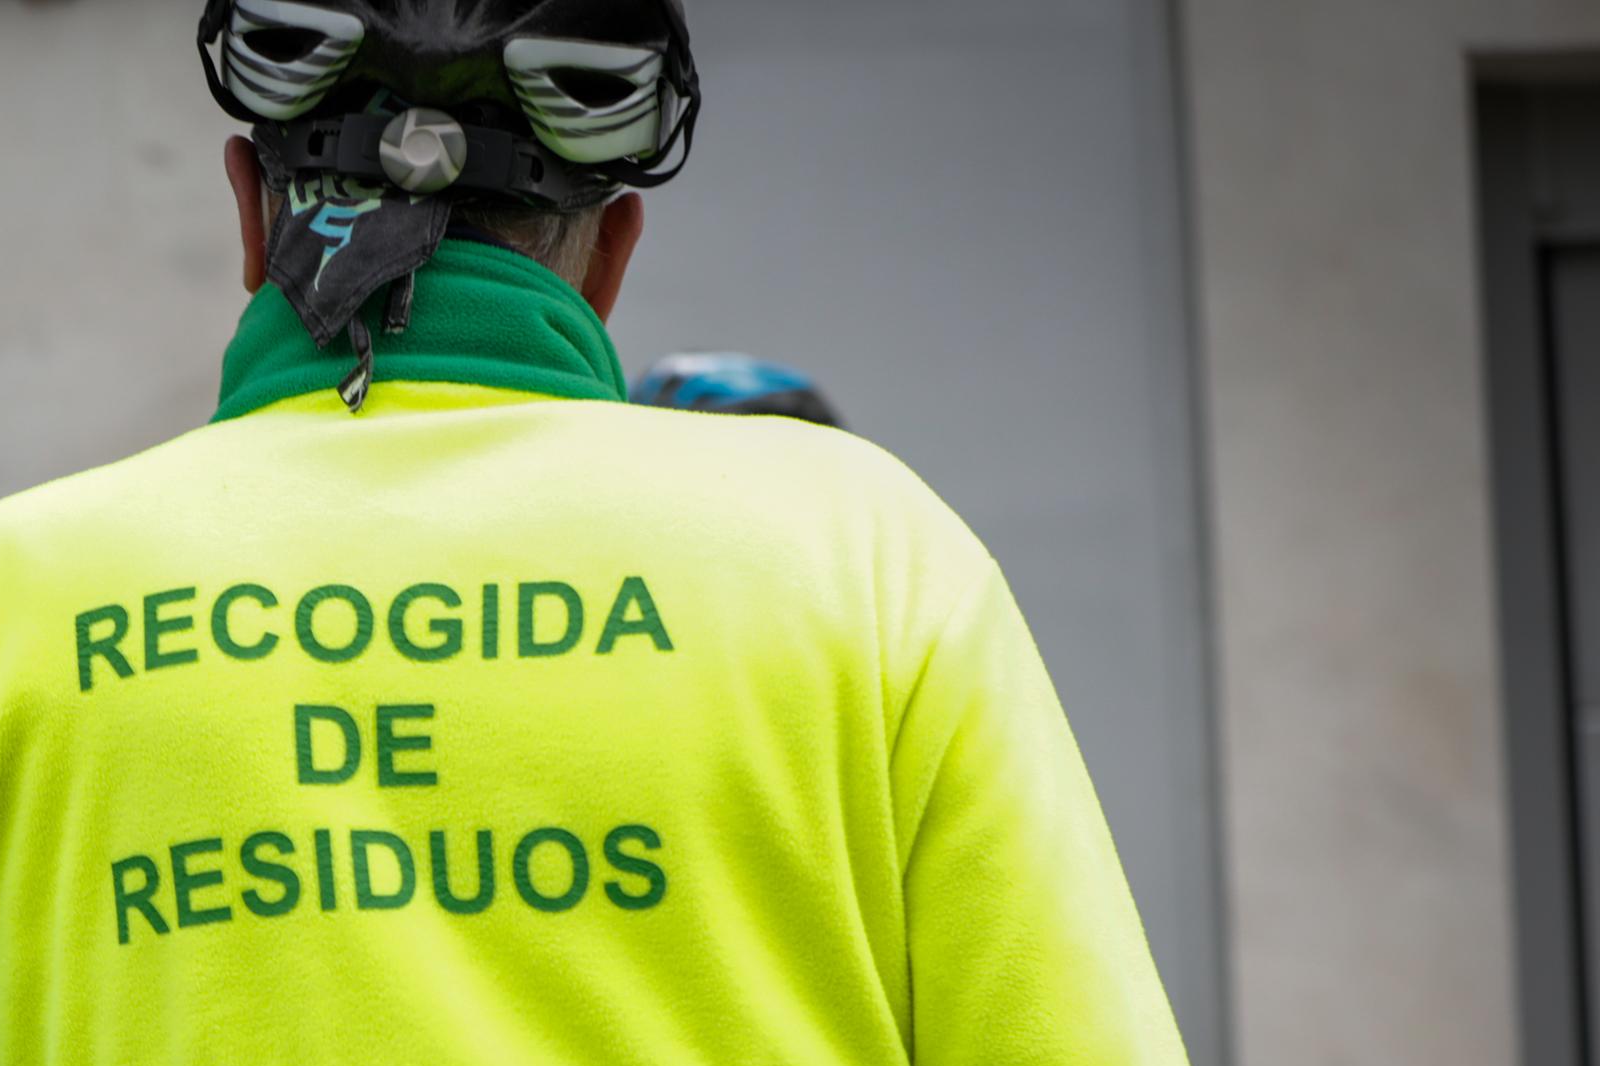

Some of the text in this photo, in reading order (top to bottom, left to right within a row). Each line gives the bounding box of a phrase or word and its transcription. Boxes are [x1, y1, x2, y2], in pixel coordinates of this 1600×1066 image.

[75, 576, 675, 692] RECOGIDA
[294, 703, 438, 787] DE
[110, 824, 667, 945] RESIDUOS
